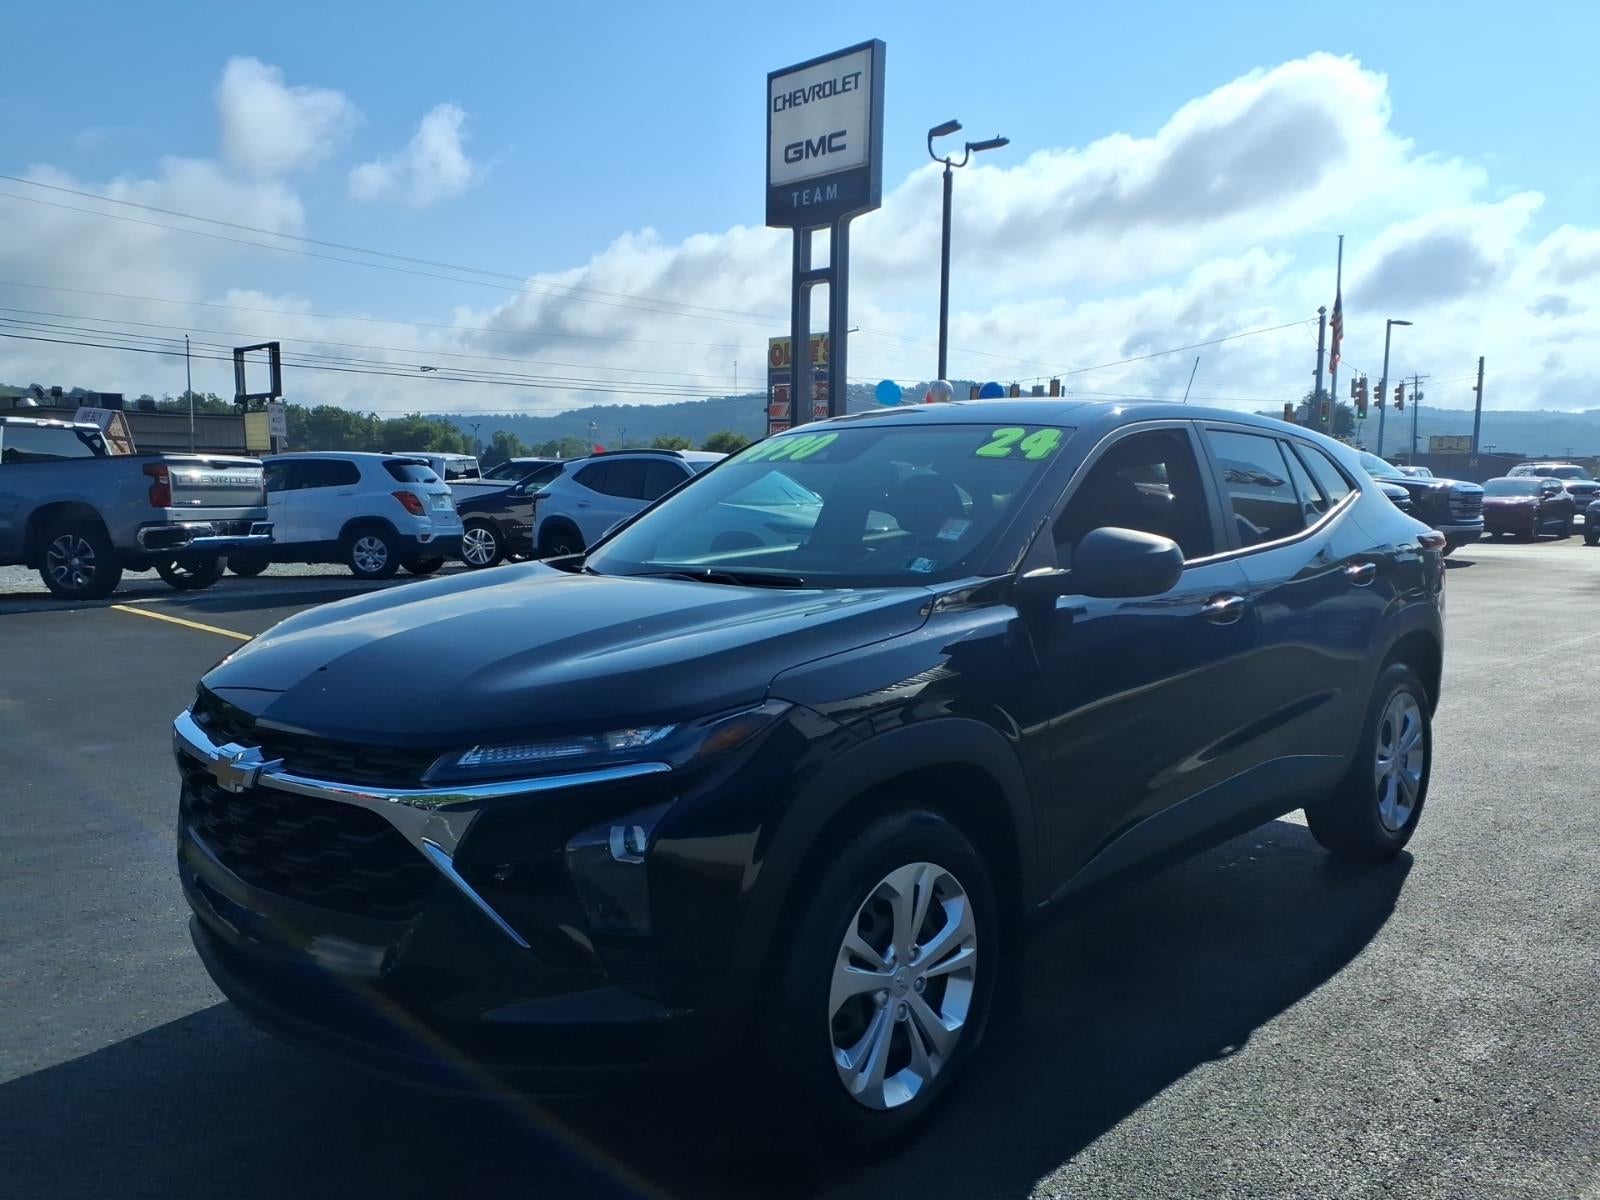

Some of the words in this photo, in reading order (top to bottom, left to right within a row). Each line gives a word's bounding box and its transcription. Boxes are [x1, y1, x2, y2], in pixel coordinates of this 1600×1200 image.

[773, 72, 862, 113] CHEVROLET
[784, 130, 847, 164] GMC
[791, 184, 838, 208] TEAM
[976, 427, 1063, 459] 24
